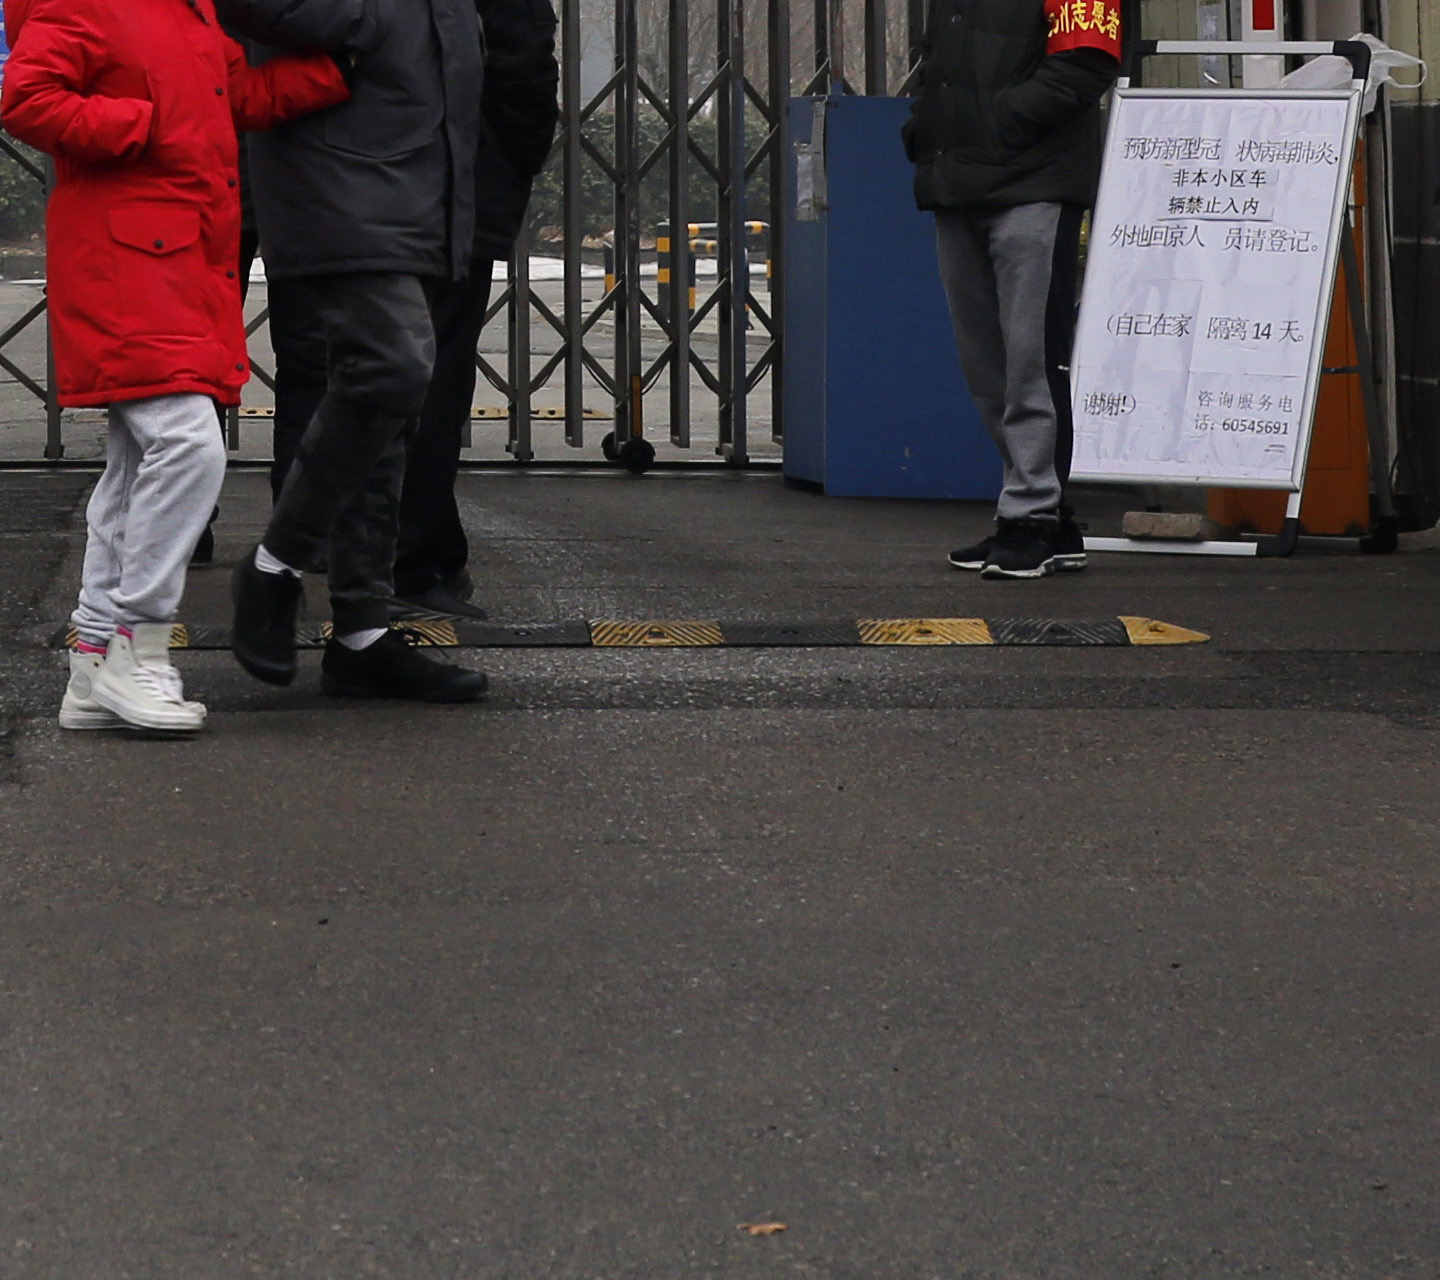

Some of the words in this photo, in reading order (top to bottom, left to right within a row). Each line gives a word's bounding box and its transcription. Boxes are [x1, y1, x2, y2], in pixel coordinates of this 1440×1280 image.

[1123, 137, 1222, 161] 预防新型冠
[1172, 168, 1267, 188] 非本小区车
[1167, 196, 1259, 215] 辆禁止入内
[1109, 224, 1206, 248] 外地回京人
[1221, 227, 1319, 253] 员请登记。
[1252, 322, 1272, 341] 14
[1197, 390, 1293, 414] 咨询服务电
